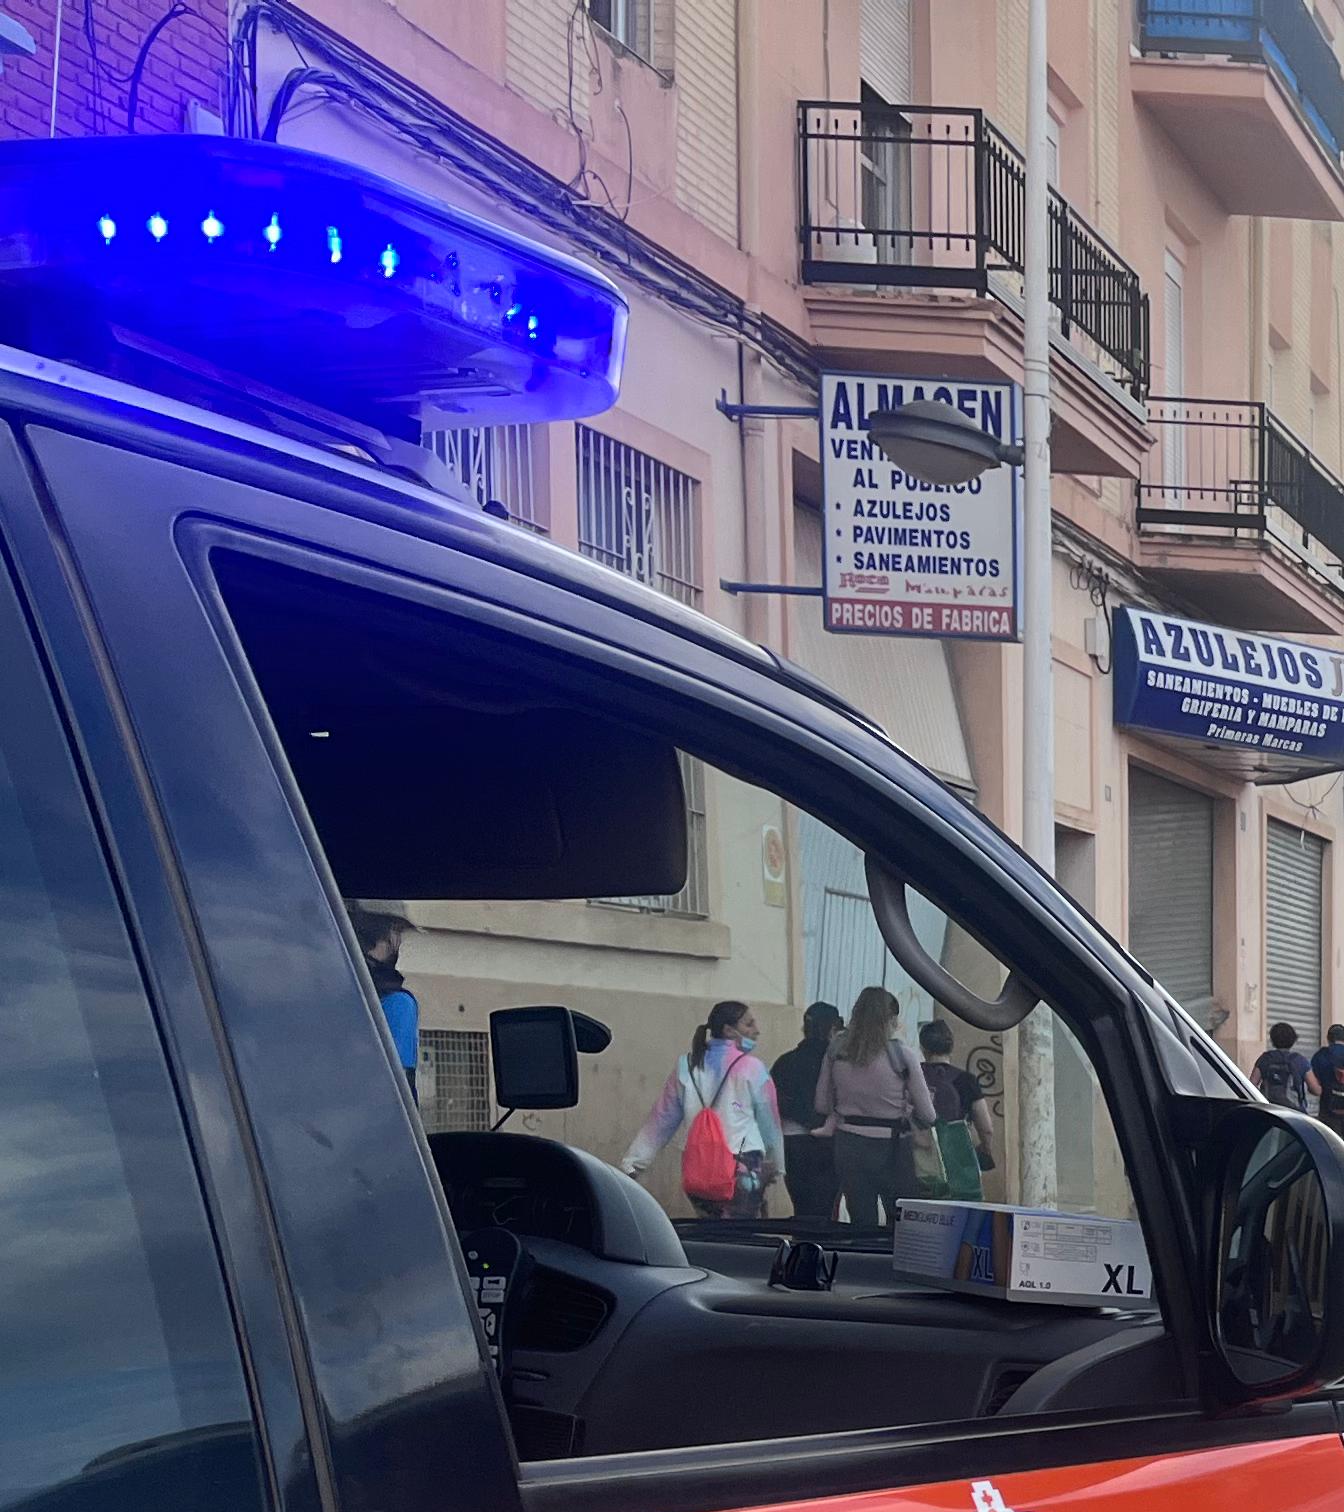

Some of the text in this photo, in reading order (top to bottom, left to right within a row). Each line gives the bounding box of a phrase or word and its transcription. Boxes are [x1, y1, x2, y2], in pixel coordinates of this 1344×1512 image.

[853, 468, 878, 489] AL
[853, 498, 950, 522] AZULEJOS
[853, 525, 970, 550] PAVIMENTOS
[854, 551, 1000, 577] SANEAMIENTOS
[831, 602, 1011, 634] PRECIOS DE FABRICA
[1139, 616, 1323, 690] AZULEJOS
[1146, 669, 1249, 704] SANEAMIENTOS
[1262, 691, 1319, 718] MUEBLES
[1322, 706, 1339, 722] DE
[1181, 697, 1328, 738] GRIFERIA Y MAMPARAS
[1262, 733, 1304, 753] Marcas
[971, 1245, 995, 1281] XL
[1101, 1263, 1144, 1295] XL
